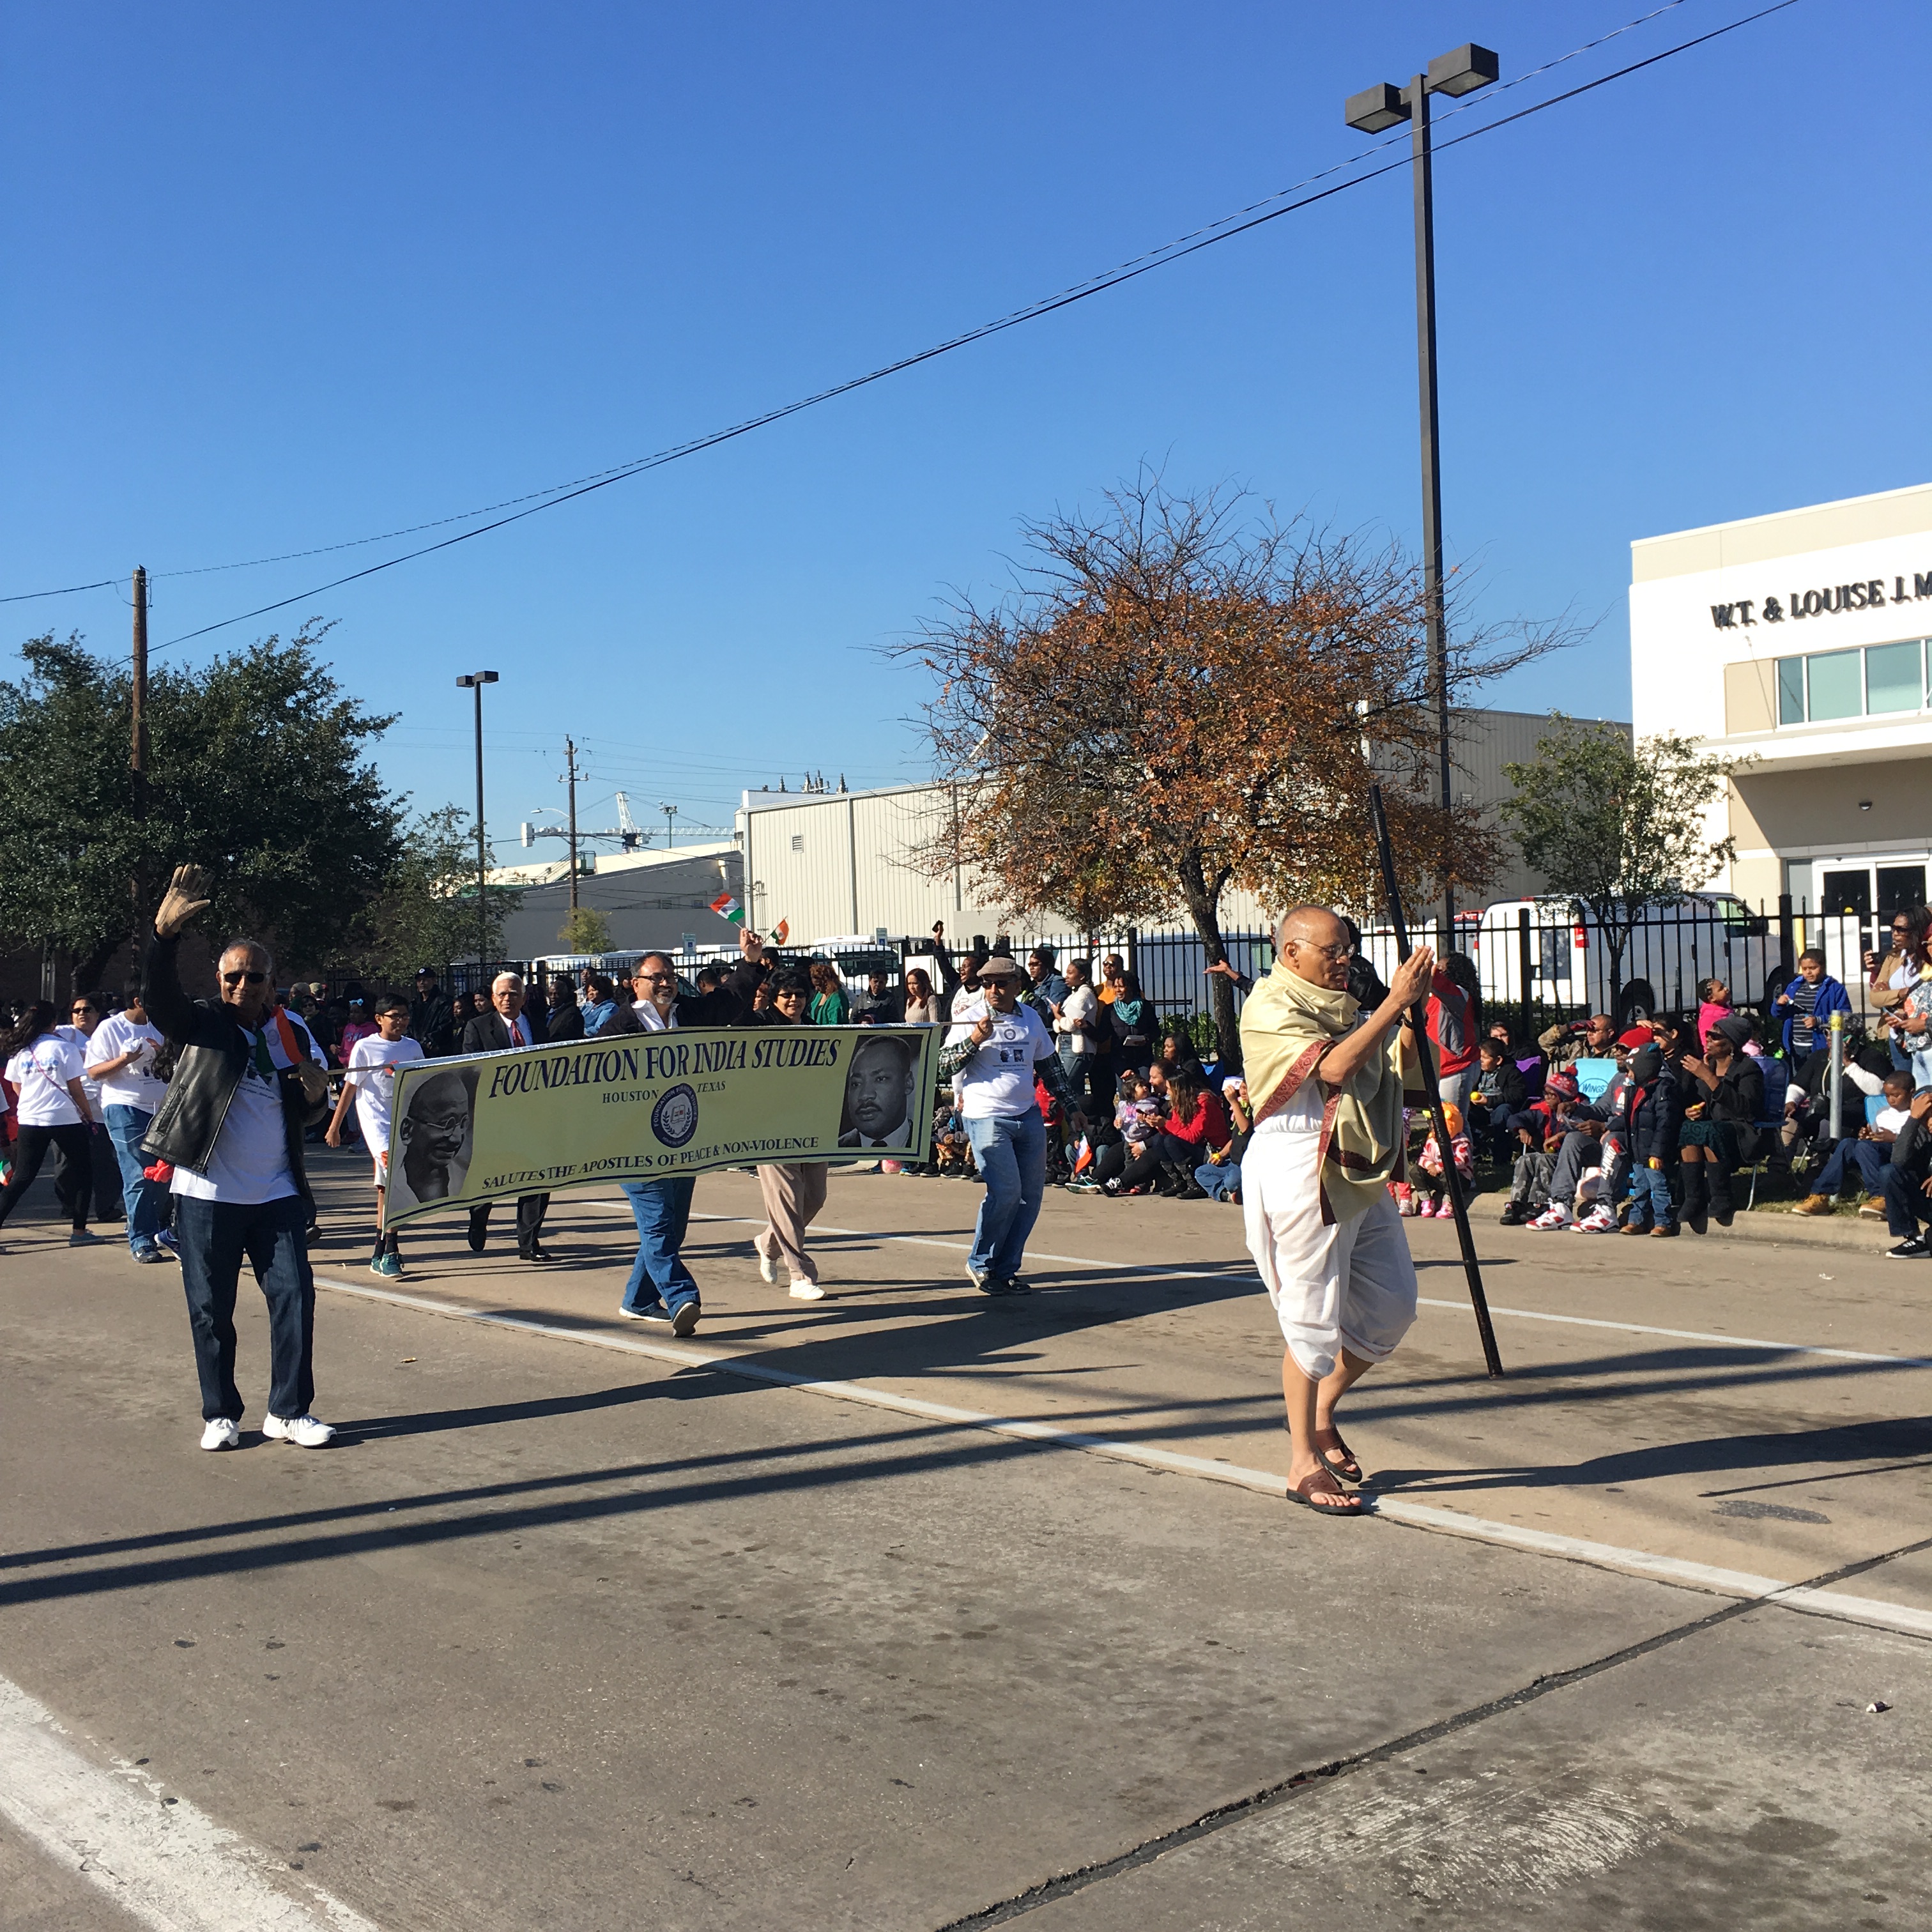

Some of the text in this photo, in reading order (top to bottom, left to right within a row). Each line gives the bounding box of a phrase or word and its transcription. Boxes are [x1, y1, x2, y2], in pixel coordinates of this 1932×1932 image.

[1763, 597, 1784, 622] &
[1790, 579, 1885, 618] LOUISE
[488, 1039, 842, 1098] FOUNDATION FOR INDIA STUDIES
[602, 1089, 659, 1103] HOUSTON
[696, 1080, 726, 1093] TEXAS
[653, 1089, 676, 1127] FOUNDATION
[482, 1137, 819, 1190] SALUTES THE APOSTLES OF PEACE & NON-VIOLENCE
